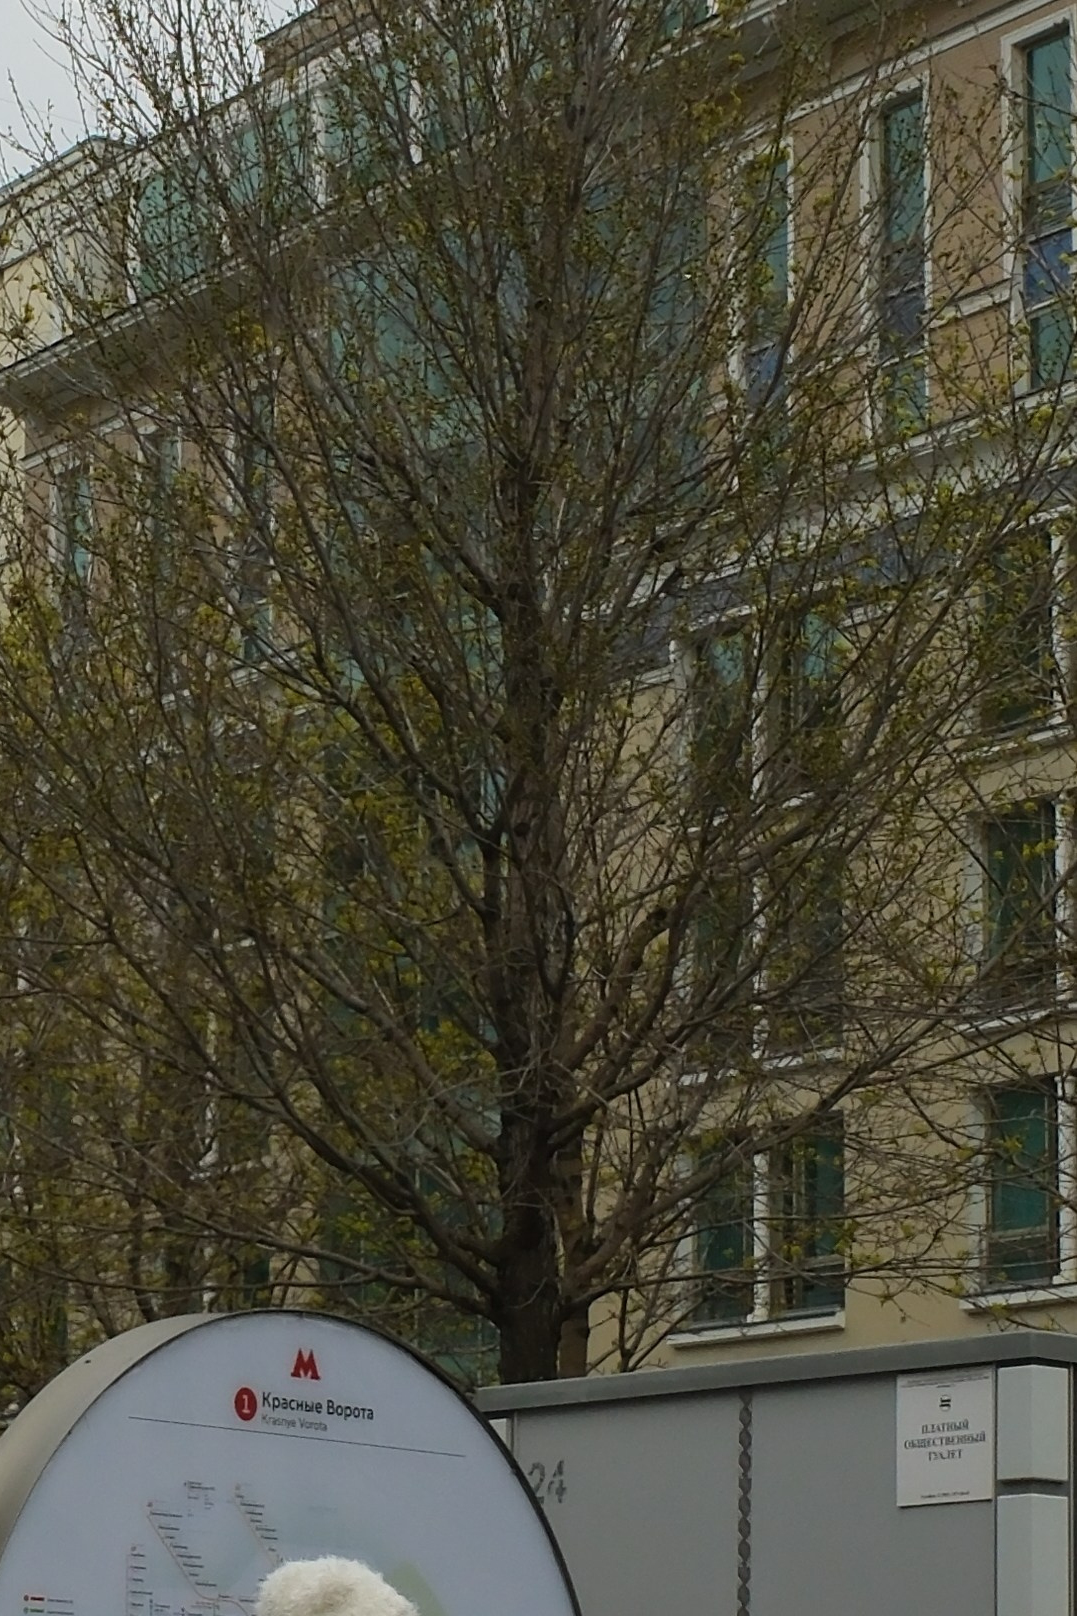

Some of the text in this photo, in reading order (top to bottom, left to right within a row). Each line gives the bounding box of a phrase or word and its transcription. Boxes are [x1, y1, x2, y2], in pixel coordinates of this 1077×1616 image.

[262, 1391, 323, 1414] Красные
[326, 1399, 374, 1421] Ворота
[262, 1414, 328, 1432] Krasnye Vorota
